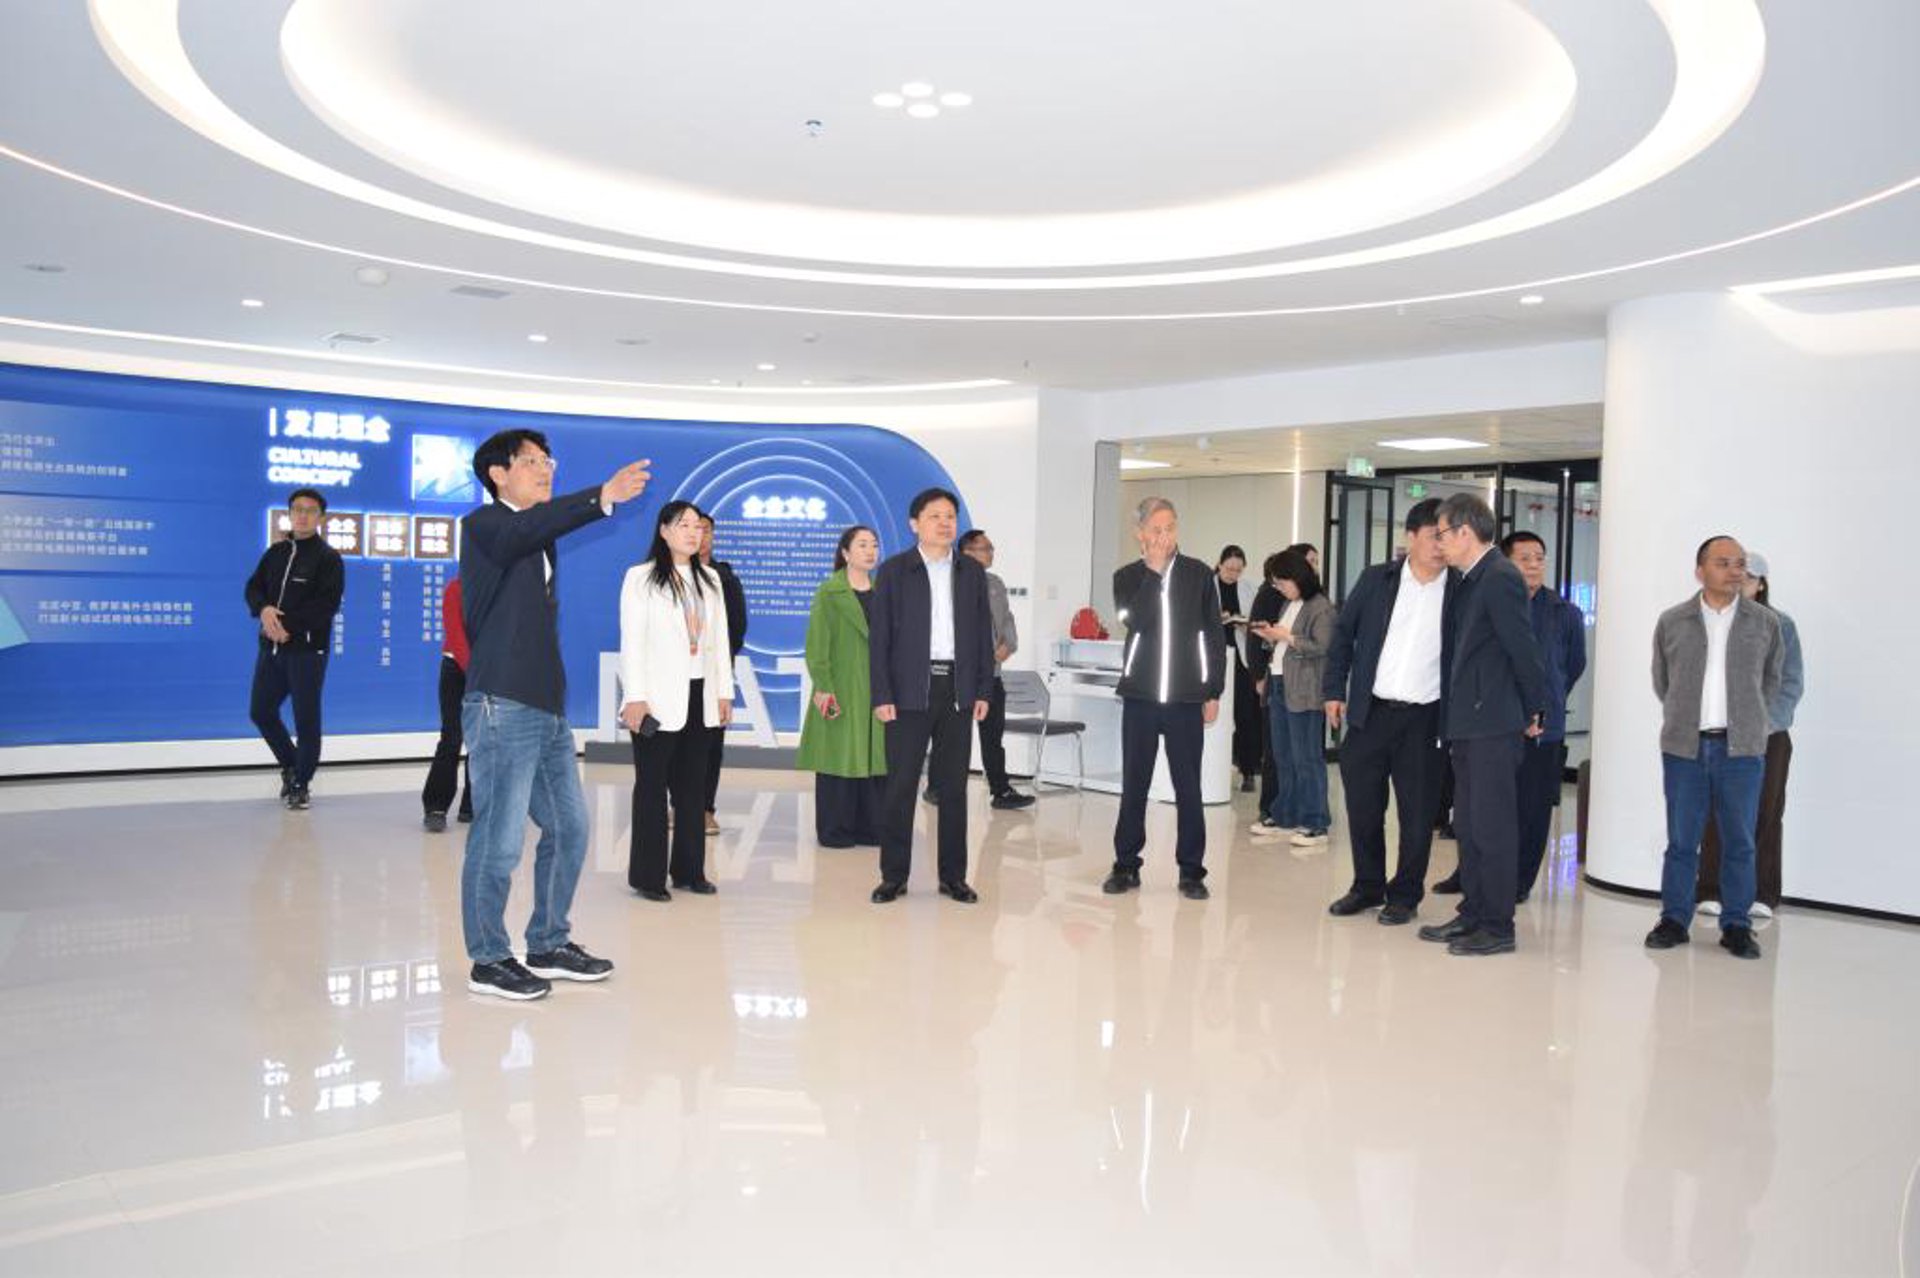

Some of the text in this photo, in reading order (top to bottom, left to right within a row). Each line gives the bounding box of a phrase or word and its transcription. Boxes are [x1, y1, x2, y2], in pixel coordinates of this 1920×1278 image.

[268, 447, 361, 469] CULTURAL
[268, 466, 353, 487] CONCEPT
[742, 495, 827, 520] 企业文化
